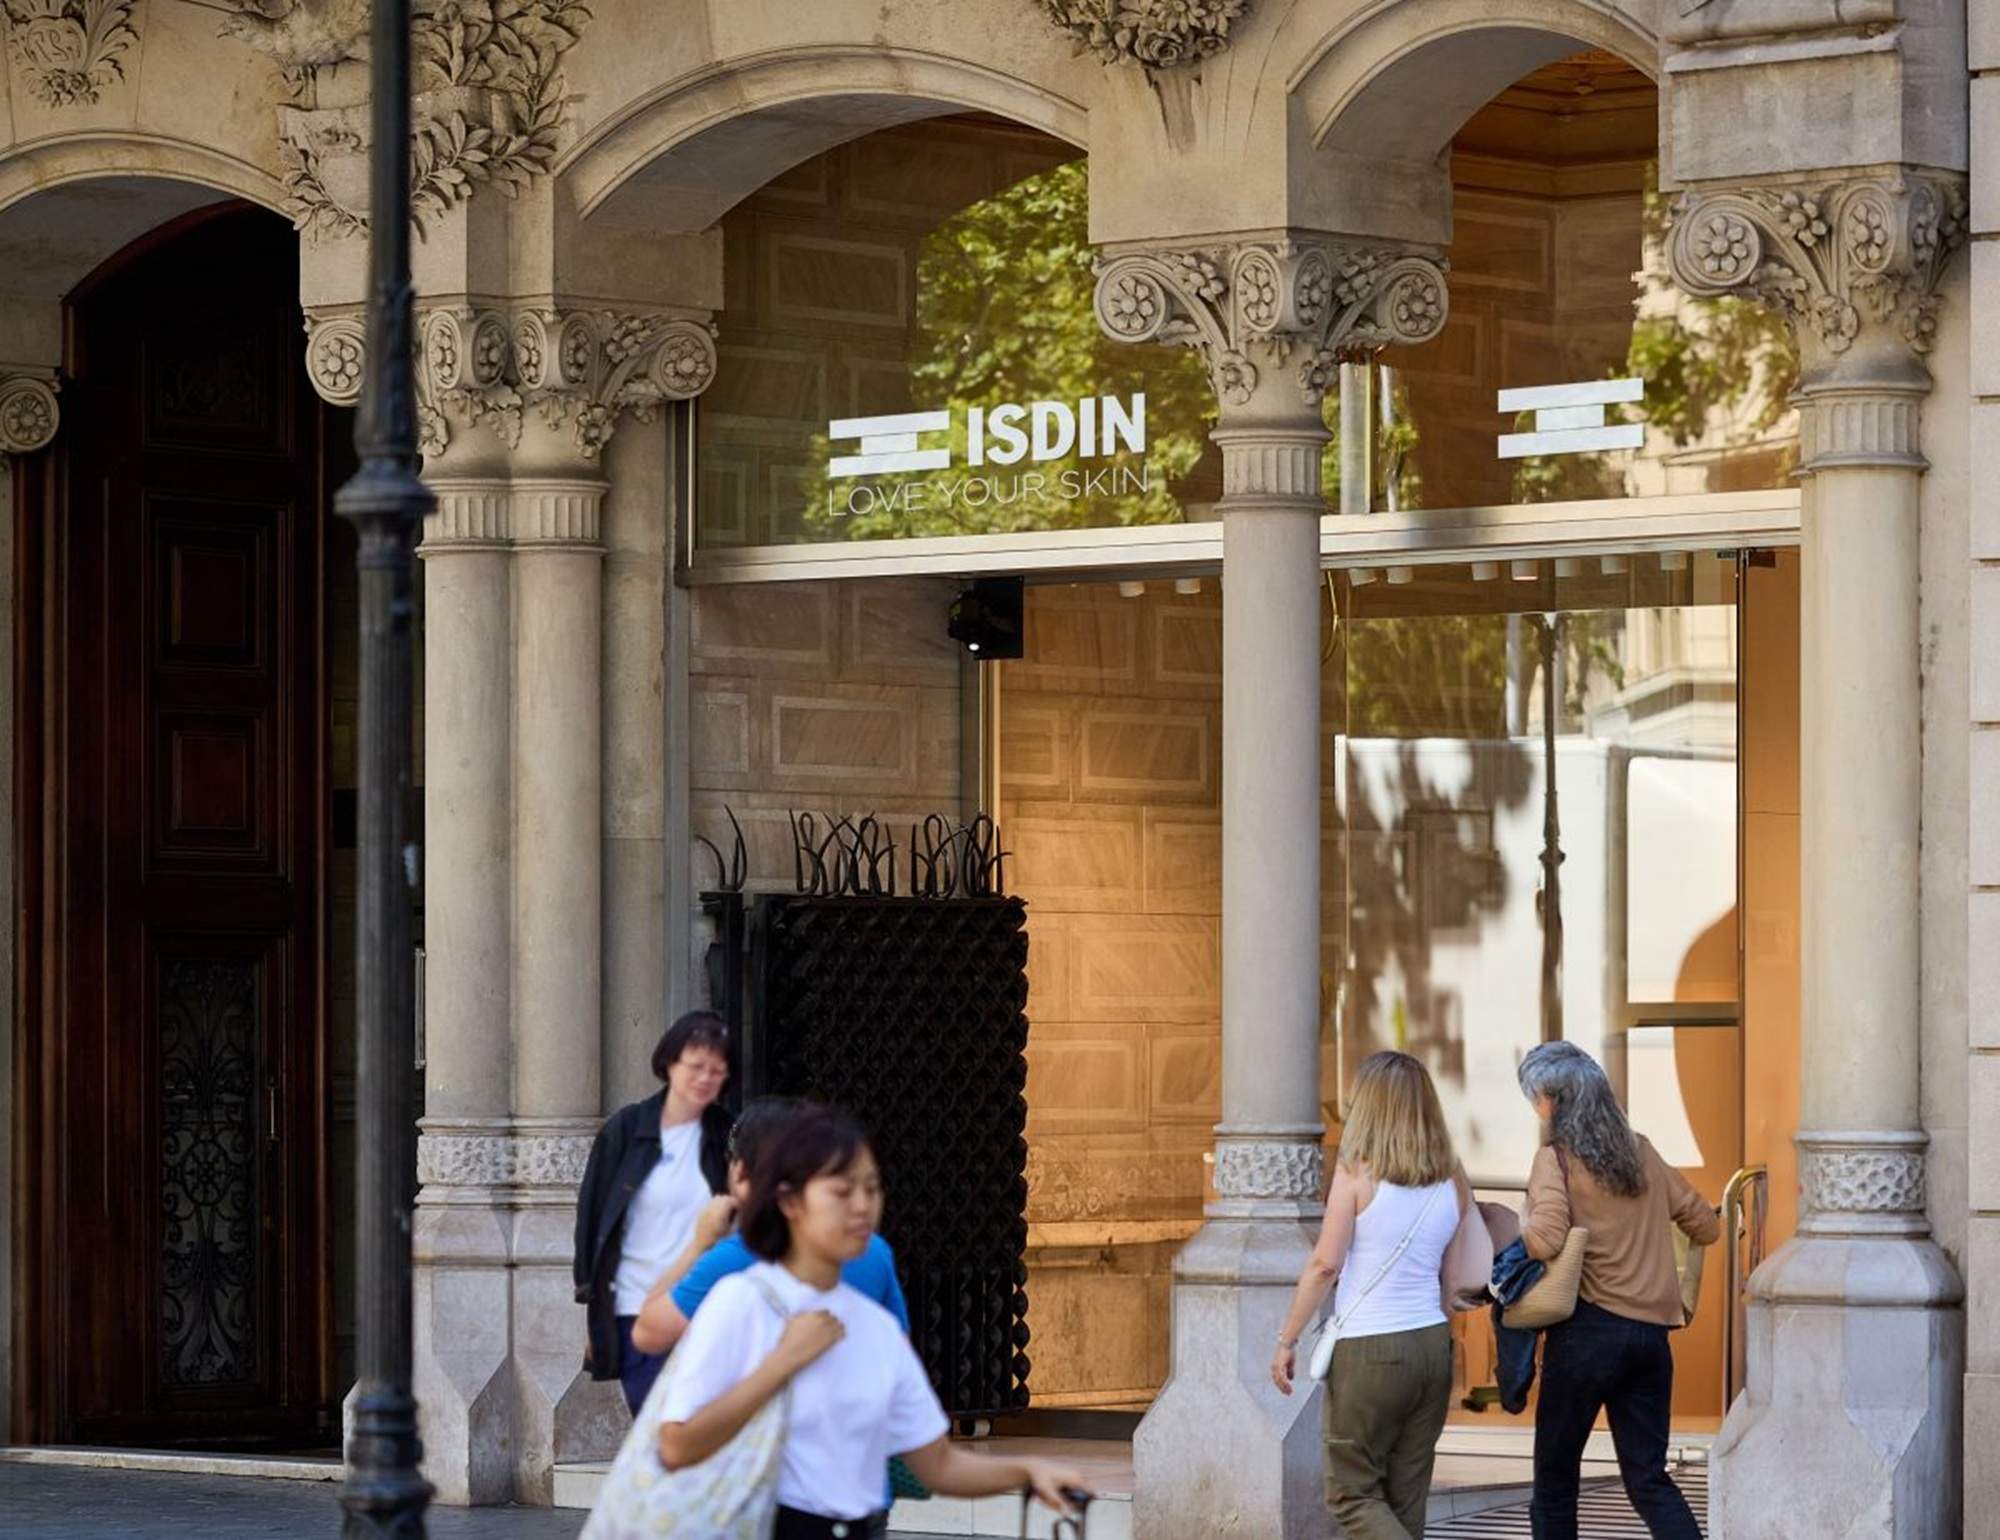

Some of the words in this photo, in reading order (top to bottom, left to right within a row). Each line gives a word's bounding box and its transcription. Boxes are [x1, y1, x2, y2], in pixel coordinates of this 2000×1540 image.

[967, 392, 1146, 467] ISDIN
[828, 482, 925, 517] LOVE
[939, 472, 1047, 506] YOUR
[1060, 466, 1150, 500] SKIN
